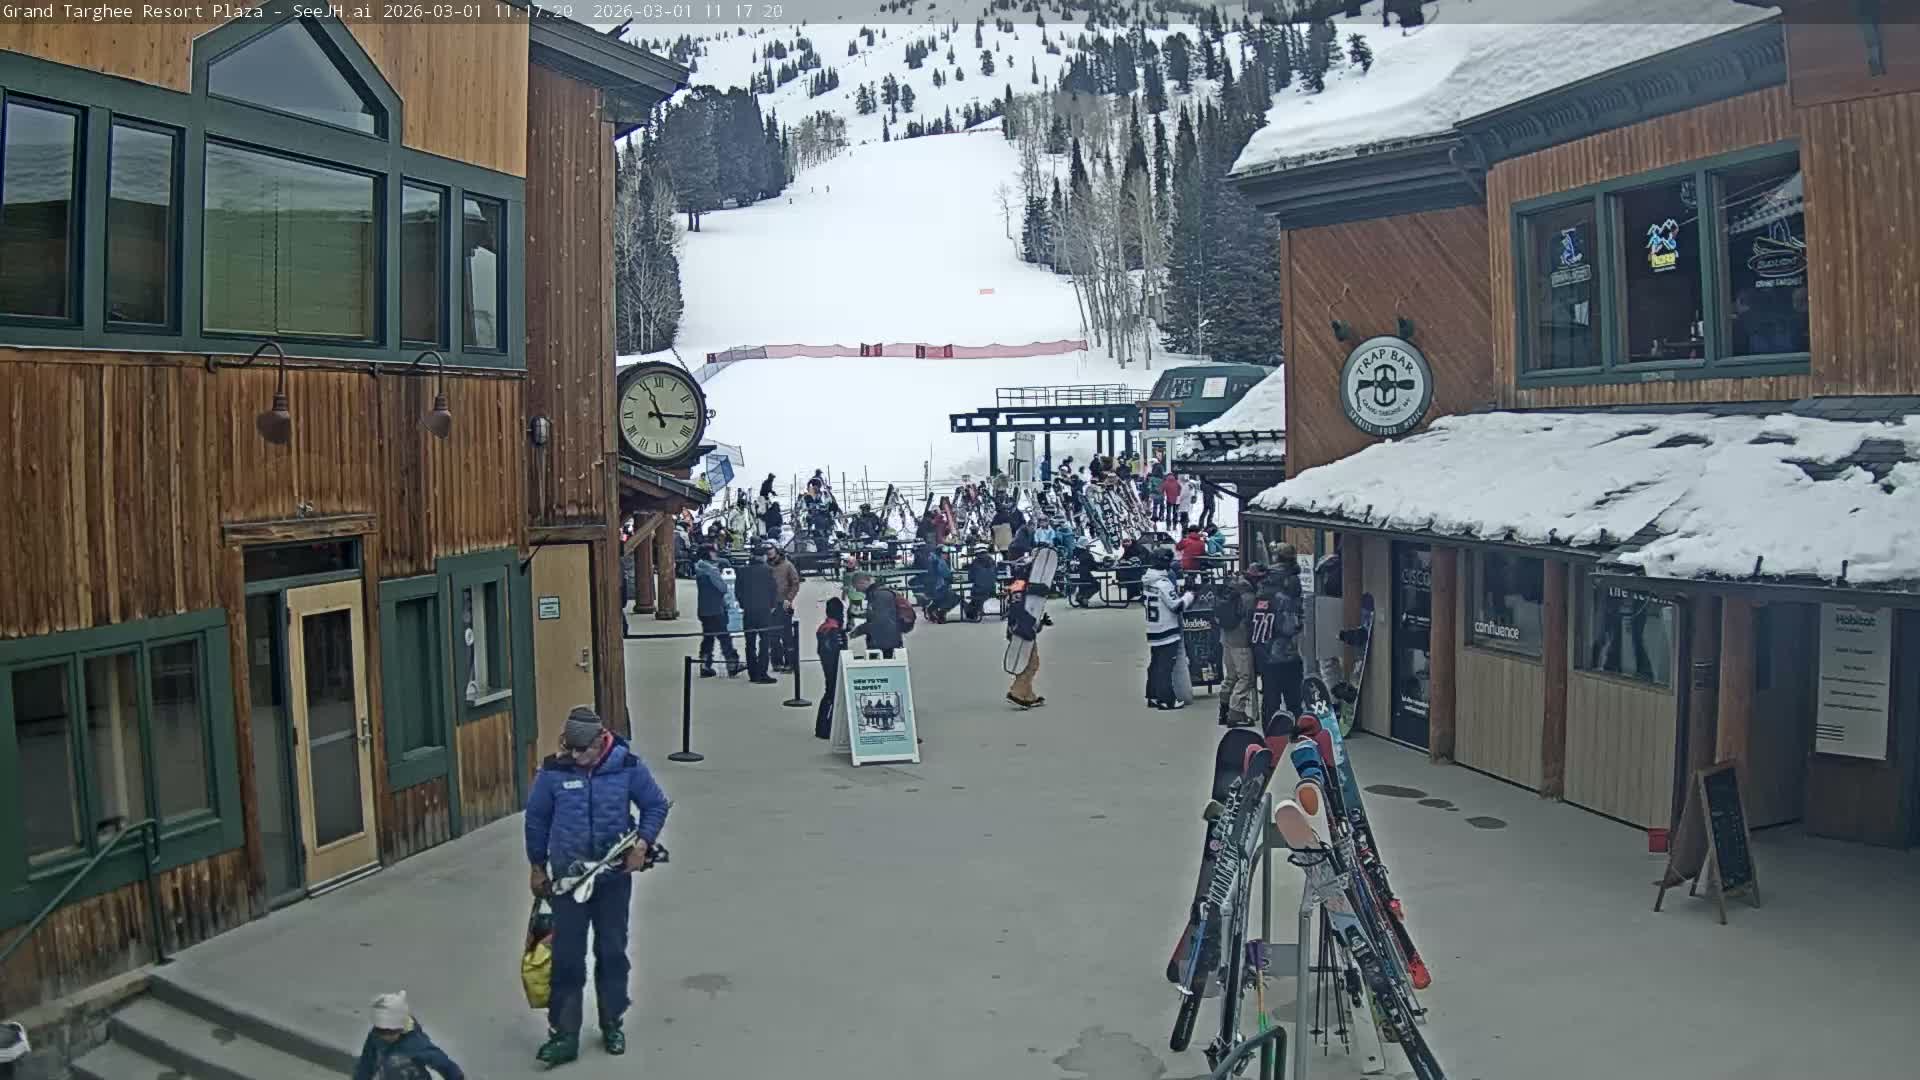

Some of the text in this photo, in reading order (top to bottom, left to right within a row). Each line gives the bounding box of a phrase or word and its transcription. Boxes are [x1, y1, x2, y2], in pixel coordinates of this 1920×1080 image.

[1356, 348, 1414, 376] TRAP BAR
[1836, 613, 1876, 628] Habitat
[1474, 621, 1520, 640] confluence
